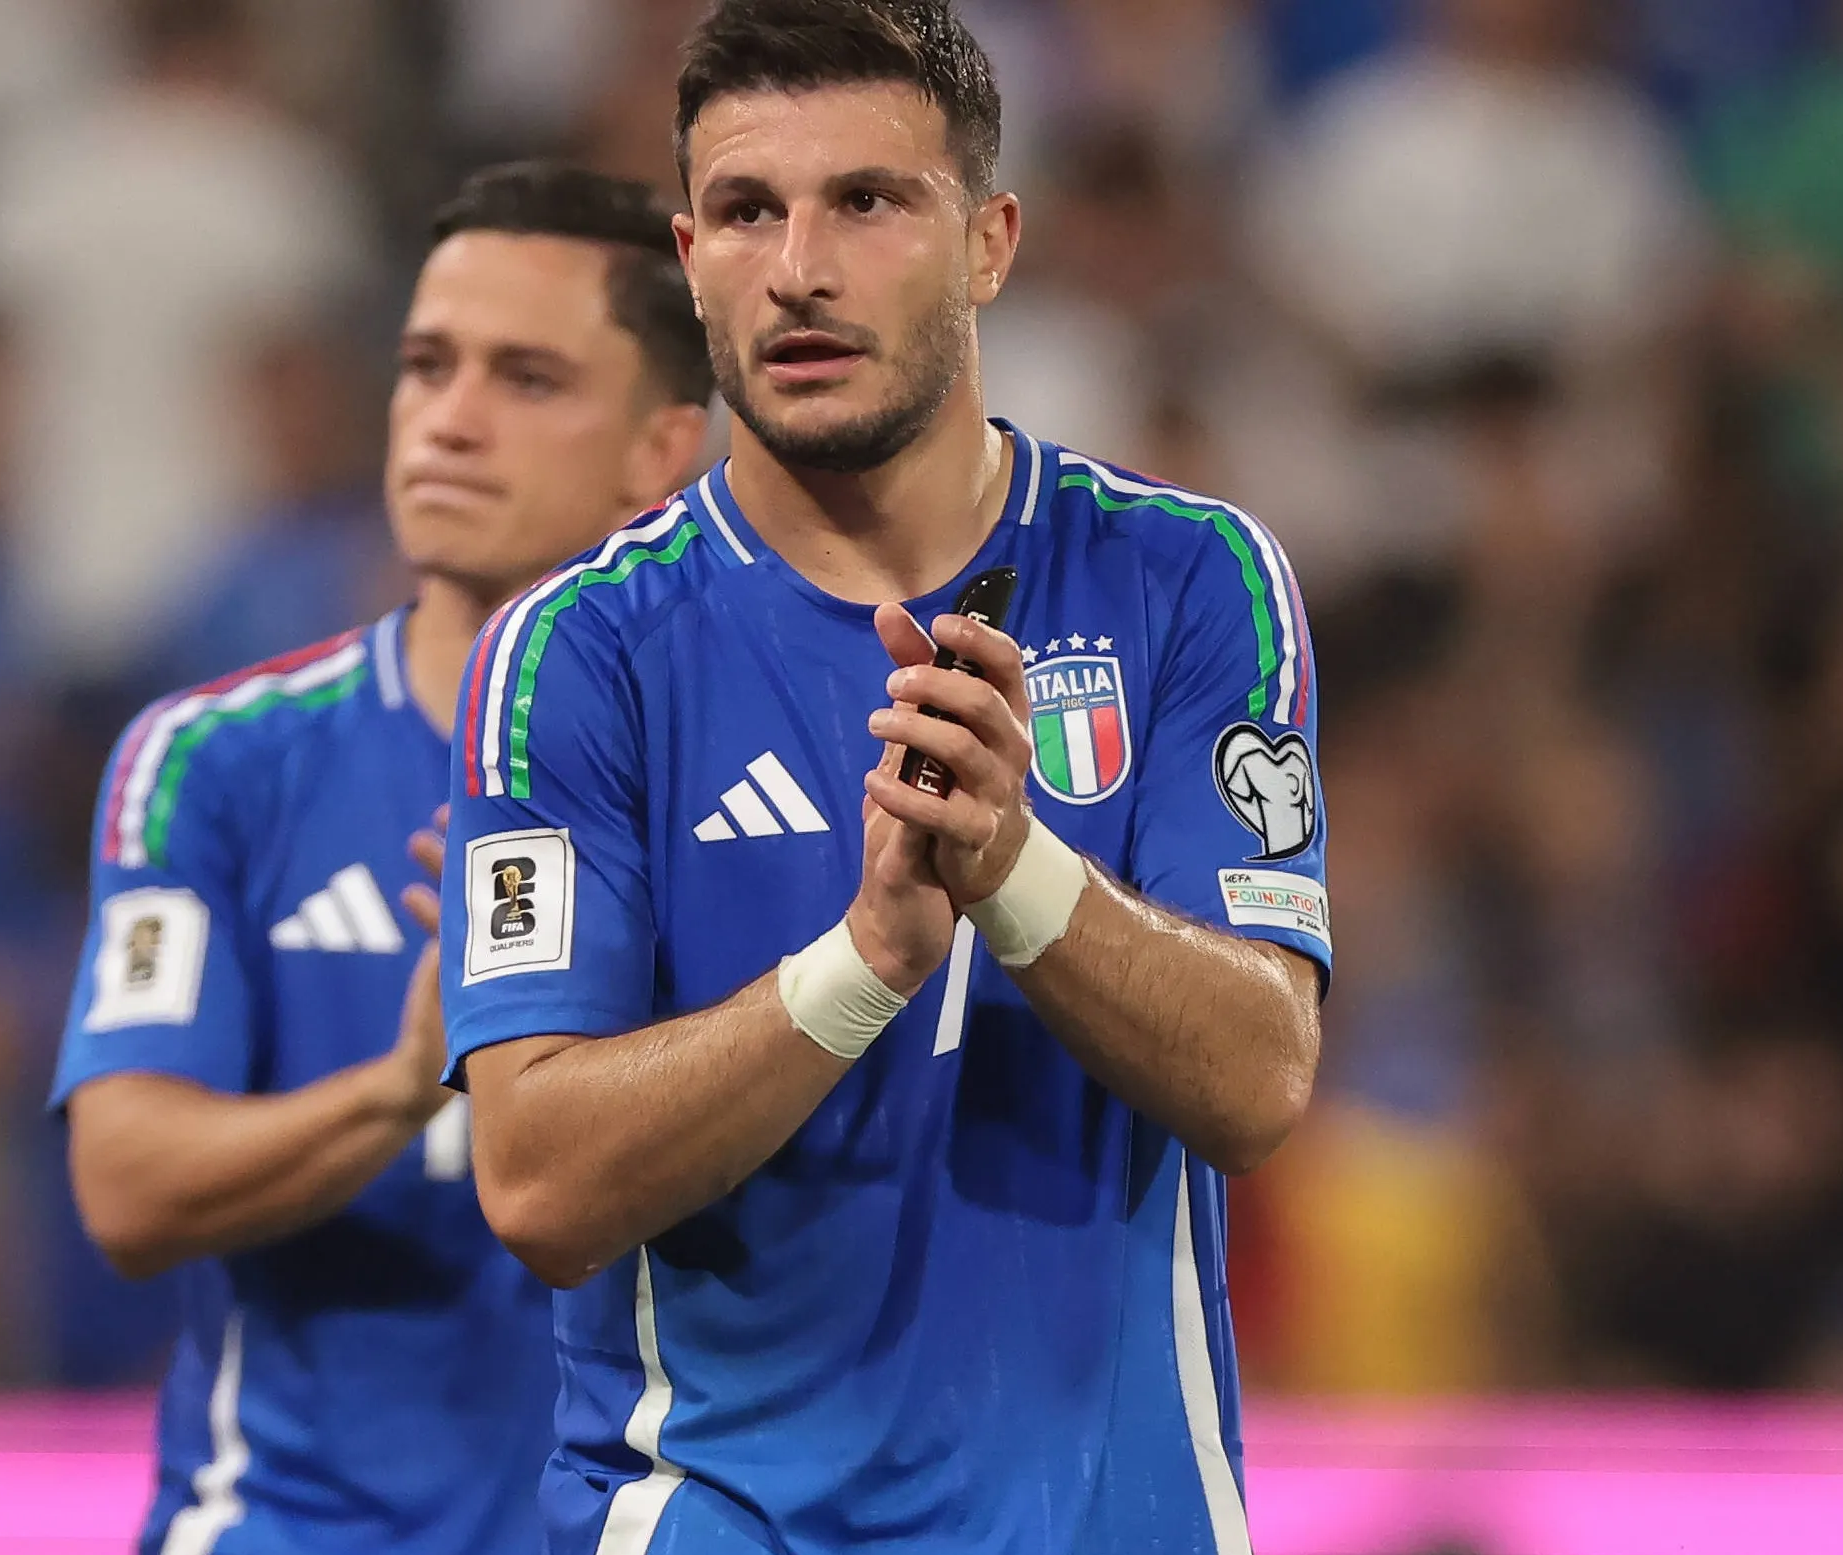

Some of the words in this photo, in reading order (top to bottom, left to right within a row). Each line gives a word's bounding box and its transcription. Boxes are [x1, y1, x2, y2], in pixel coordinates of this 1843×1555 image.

[1029, 667, 1114, 702] ITALIA
[1061, 698, 1086, 709] FIGC
[1223, 873, 1252, 884] UEFA
[501, 921, 525, 933] FIFA
